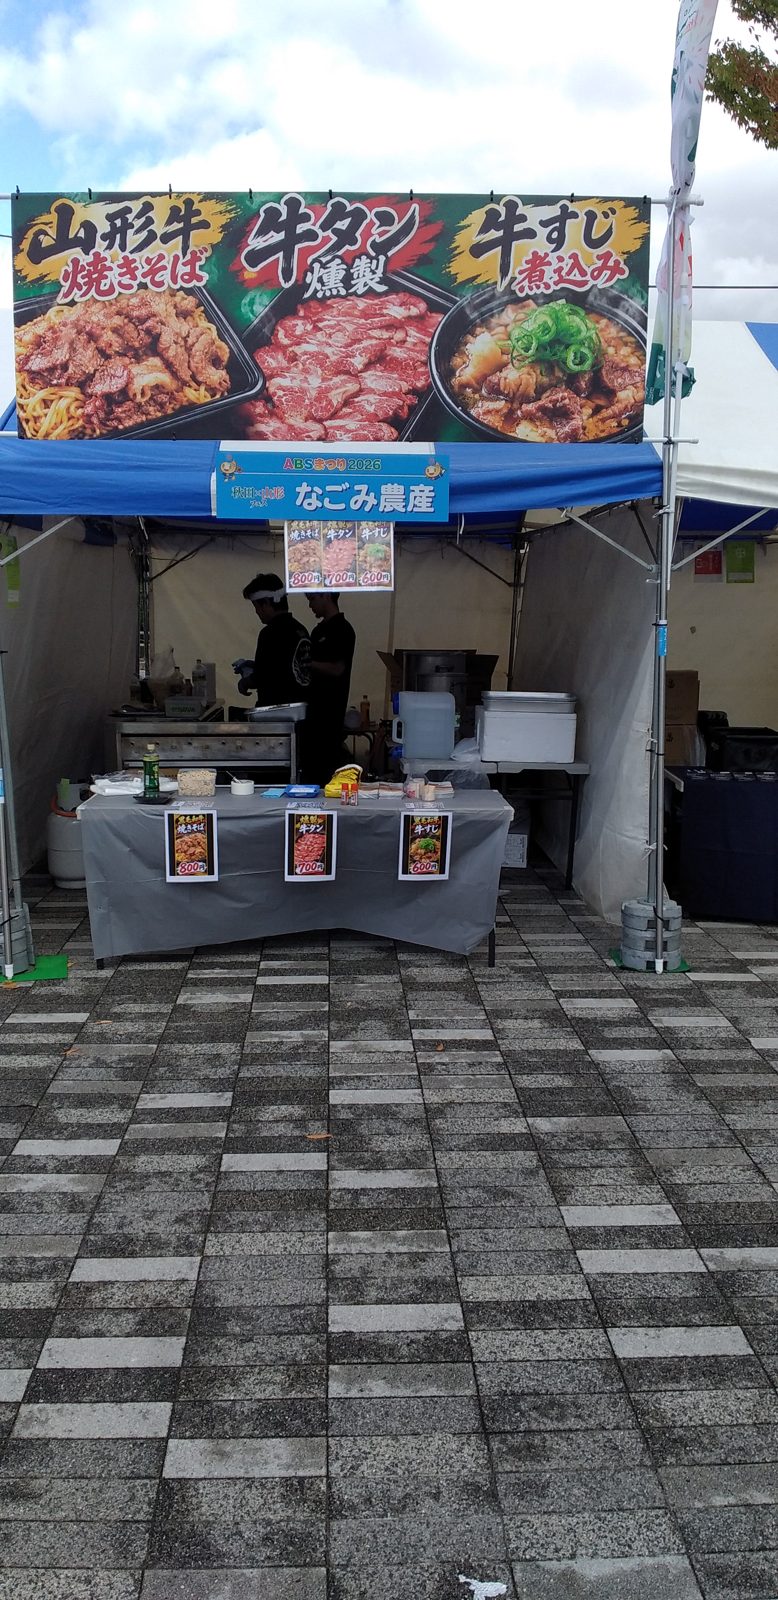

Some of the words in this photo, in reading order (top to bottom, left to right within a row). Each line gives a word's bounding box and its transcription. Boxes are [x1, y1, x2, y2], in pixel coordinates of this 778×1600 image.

[27, 197, 210, 265] 山形牛
[243, 194, 420, 288] 牛タン
[469, 199, 618, 289] 牛すじ
[60, 246, 208, 301] 焼きそば
[304, 254, 386, 299] 燻製
[516, 250, 628, 294] 煮込み
[283, 456, 381, 471] ABSまつり2026
[295, 481, 435, 513] なごみ農産
[290, 528, 320, 540] 焼きそば
[327, 528, 353, 540] 牛タン
[361, 528, 388, 540] 牛すじ
[292, 573, 321, 586] 800円
[327, 573, 355, 585] 700円
[362, 573, 390, 585] 600円
[177, 824, 205, 833] 焼きそば
[299, 824, 323, 834] 牛タン
[414, 824, 439, 835] 牛すじ
[179, 862, 205, 873] 800円
[298, 862, 323, 873] 700円
[412, 862, 437, 872] 600円
